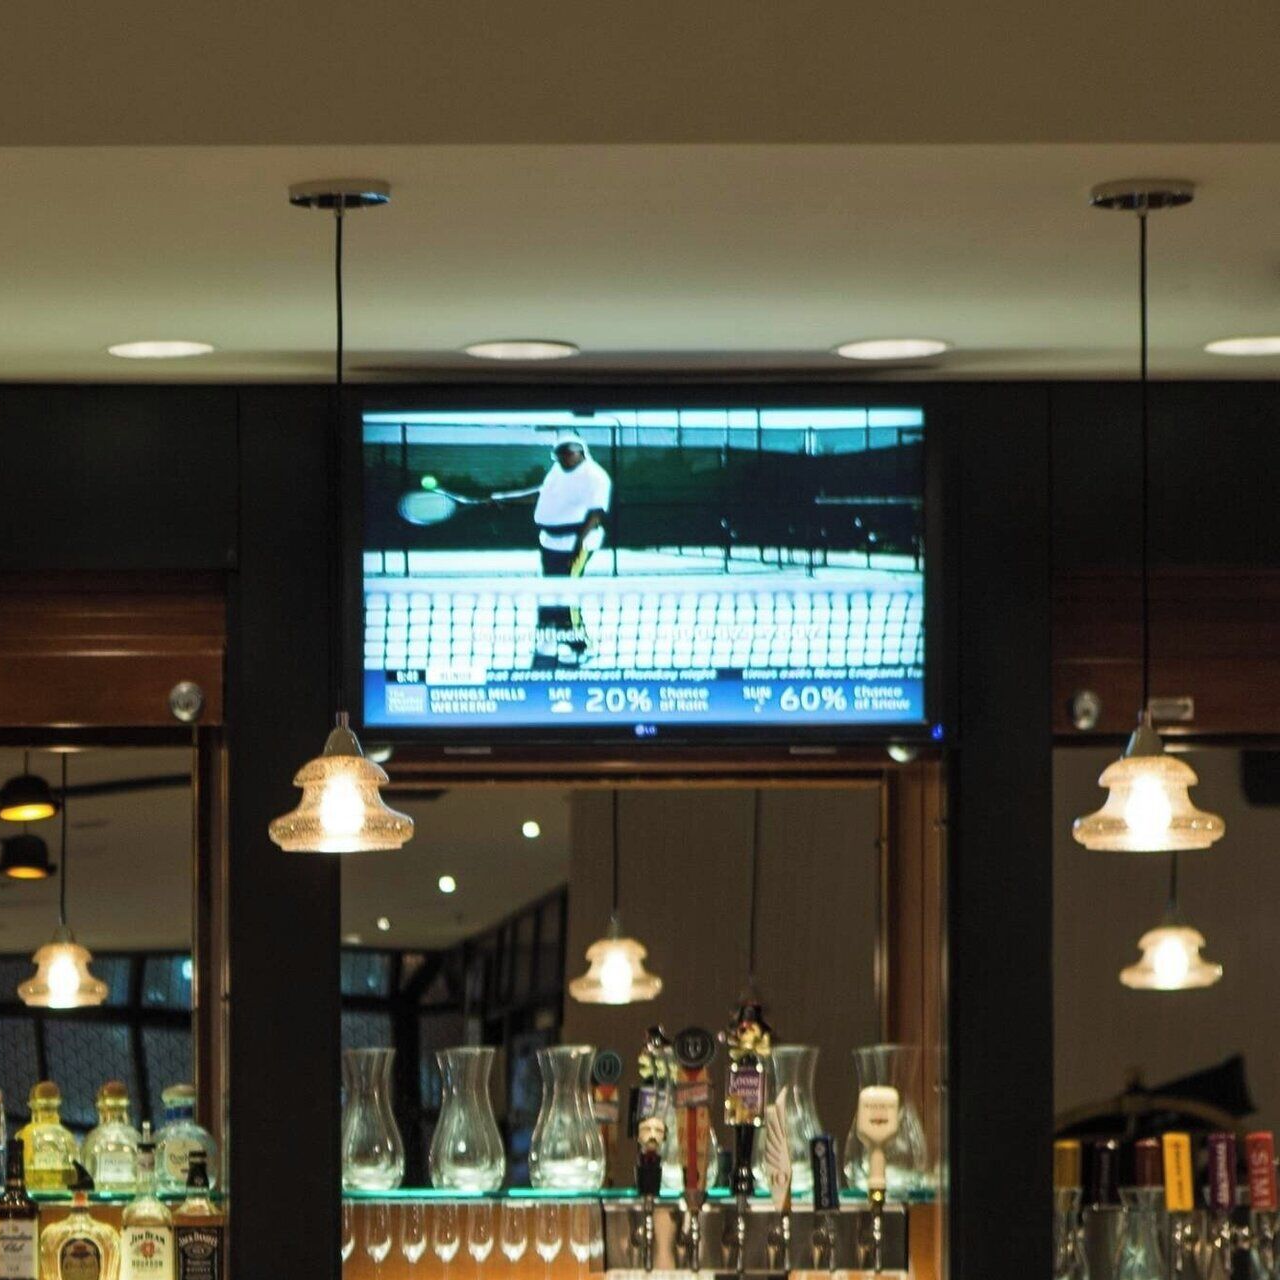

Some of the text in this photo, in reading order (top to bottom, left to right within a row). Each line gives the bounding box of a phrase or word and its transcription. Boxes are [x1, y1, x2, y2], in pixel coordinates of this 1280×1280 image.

[680, 668, 717, 682] night
[814, 667, 847, 680] New
[849, 667, 905, 681] England
[430, 687, 527, 701] OWINGS MILLS
[659, 686, 710, 699] Chance
[743, 686, 771, 700] SUN
[780, 685, 847, 711] 60%
[854, 686, 903, 699] Chance
[585, 687, 653, 713] 20%
[676, 699, 709, 712] Rain
[871, 698, 911, 711] Snow
[430, 701, 498, 714] WEEKEND
[144, 1231, 165, 1246] BEAM
